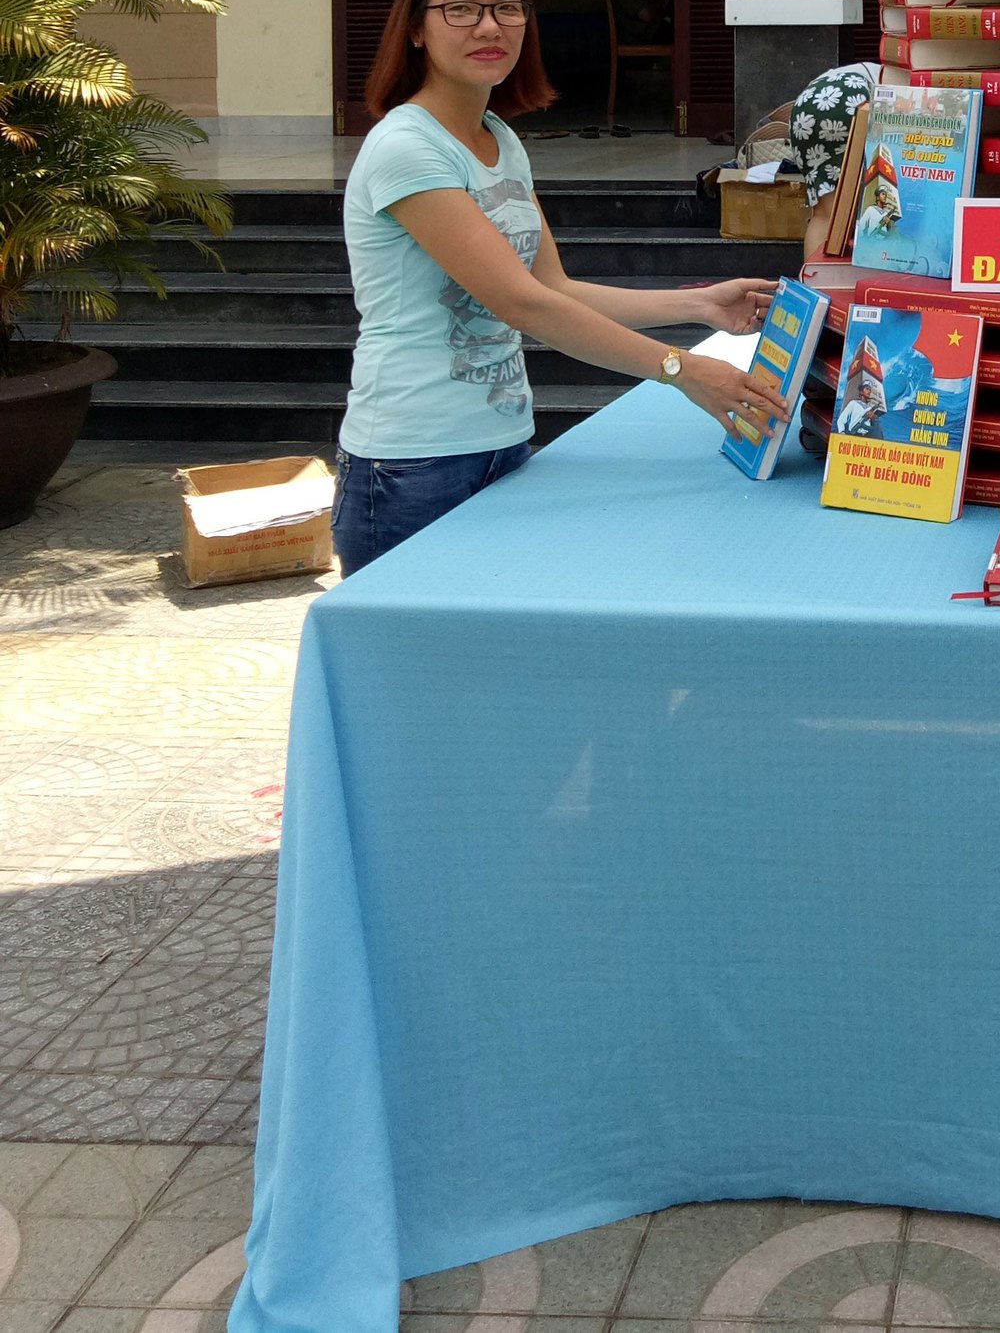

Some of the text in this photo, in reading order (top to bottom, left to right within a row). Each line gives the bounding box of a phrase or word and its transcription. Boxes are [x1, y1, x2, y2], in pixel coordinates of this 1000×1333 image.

[984, 19, 991, 31] 49
[986, 82, 993, 94] 17
[904, 131, 955, 147] BIỂN ĐẢO
[902, 146, 946, 164] TỔ QUỐC
[988, 151, 995, 162] 18
[901, 164, 955, 182] VIỆT NAM
[916, 389, 938, 406] NHỮNG
[913, 409, 947, 426] CHỨNG CỨ
[910, 425, 949, 446] KHẲNG ĐỊNH
[838, 440, 851, 455] CHỦ
[852, 441, 871, 458] QUYỀN
[889, 447, 901, 463] ĐẢO
[902, 449, 915, 465] CỦA
[915, 452, 929, 469] VIỆT
[930, 456, 945, 470] NAM
[845, 462, 932, 487] TRÊN BIỂN ĐÔNG
